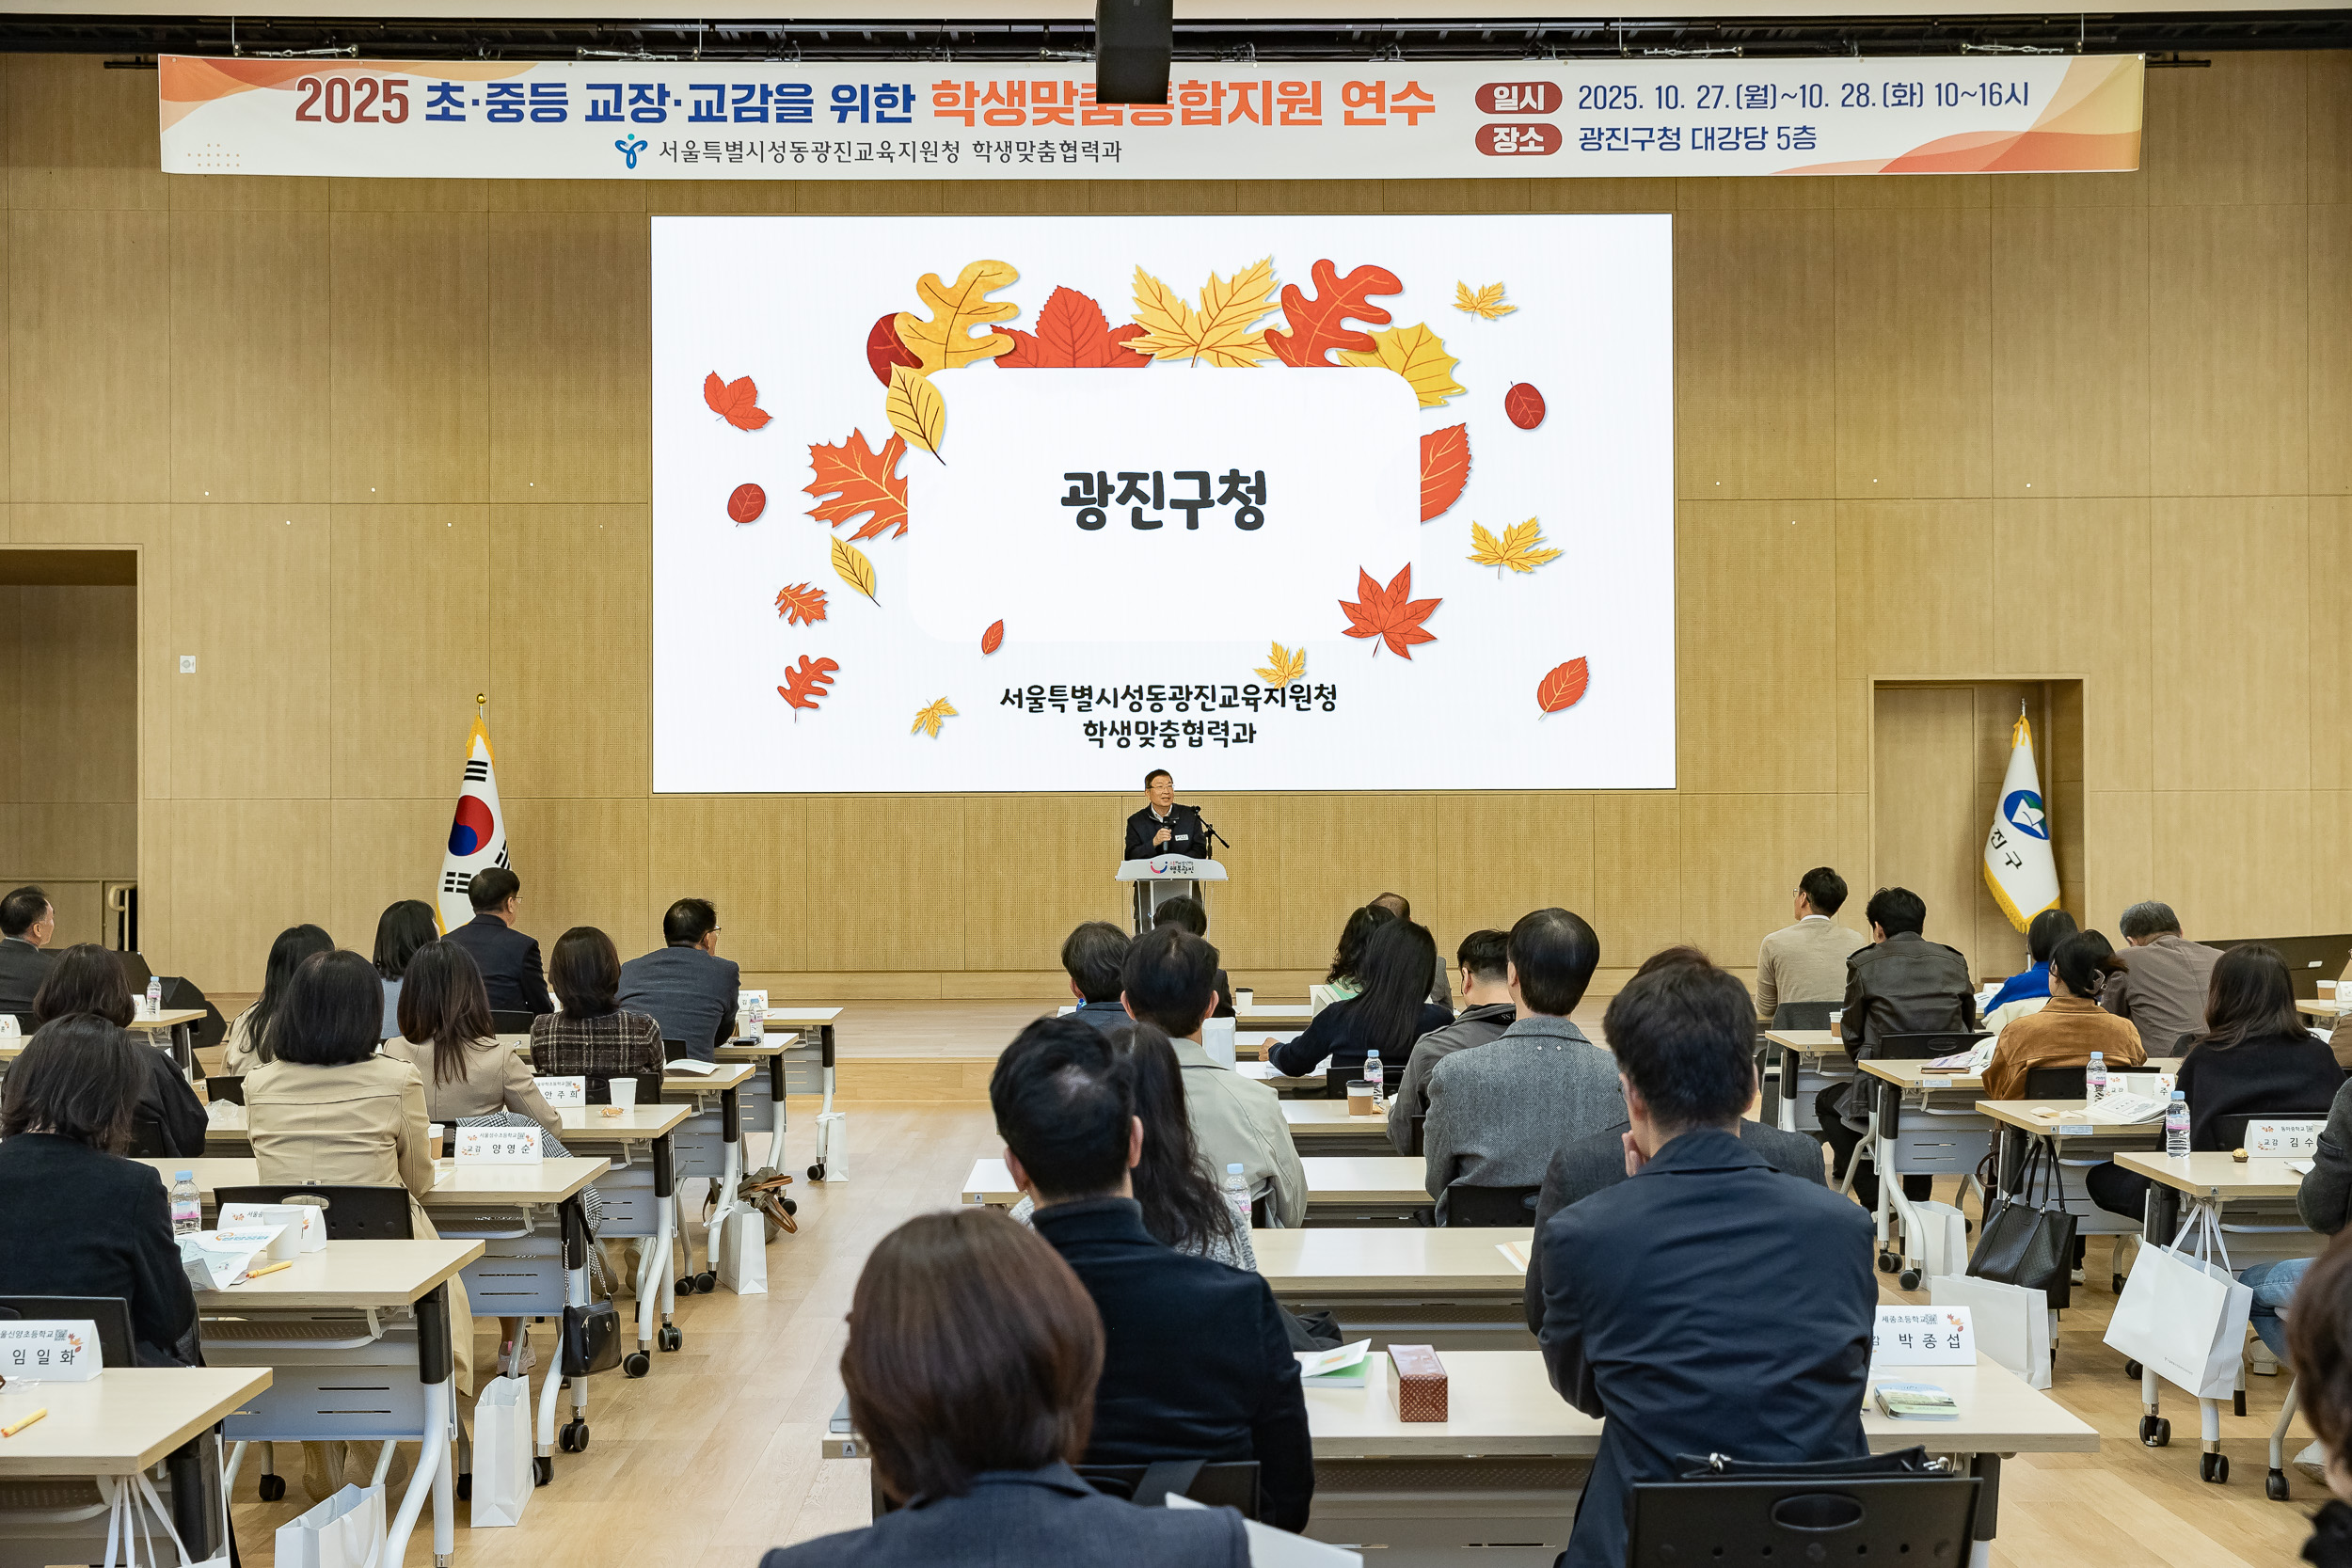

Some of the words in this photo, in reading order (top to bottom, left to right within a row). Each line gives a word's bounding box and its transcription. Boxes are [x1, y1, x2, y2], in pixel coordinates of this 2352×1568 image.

[294, 75, 409, 125] 2025
[425, 77, 568, 122] 초·중등
[585, 83, 814, 123] 교장·교감을
[830, 83, 915, 123] 위한
[1342, 81, 1435, 126] 연수
[1493, 84, 1545, 111] 일시
[1579, 86, 1643, 110] 2025.
[1655, 85, 1684, 109] 10.
[1935, 82, 2027, 106] 10~16시
[1492, 126, 1545, 153] 장소
[1579, 126, 1680, 151] 광진구청
[1692, 126, 1769, 150] 대강당
[1777, 125, 1817, 150] 5층
[660, 140, 959, 164] 서울특별시성동광진교육지원청
[972, 140, 1121, 163] 학생맞춤협력과
[1061, 468, 1266, 531] 광진구청
[999, 683, 1337, 713] 서울특별시성동광진교육지원청
[1083, 720, 1257, 749] 학생맞춤협력과
[1991, 828, 2023, 870] 진구
[2264, 1138, 2278, 1147] 교감
[2290, 1137, 2314, 1148] 김수
[0, 1329, 54, 1338] 울신양초등학교
